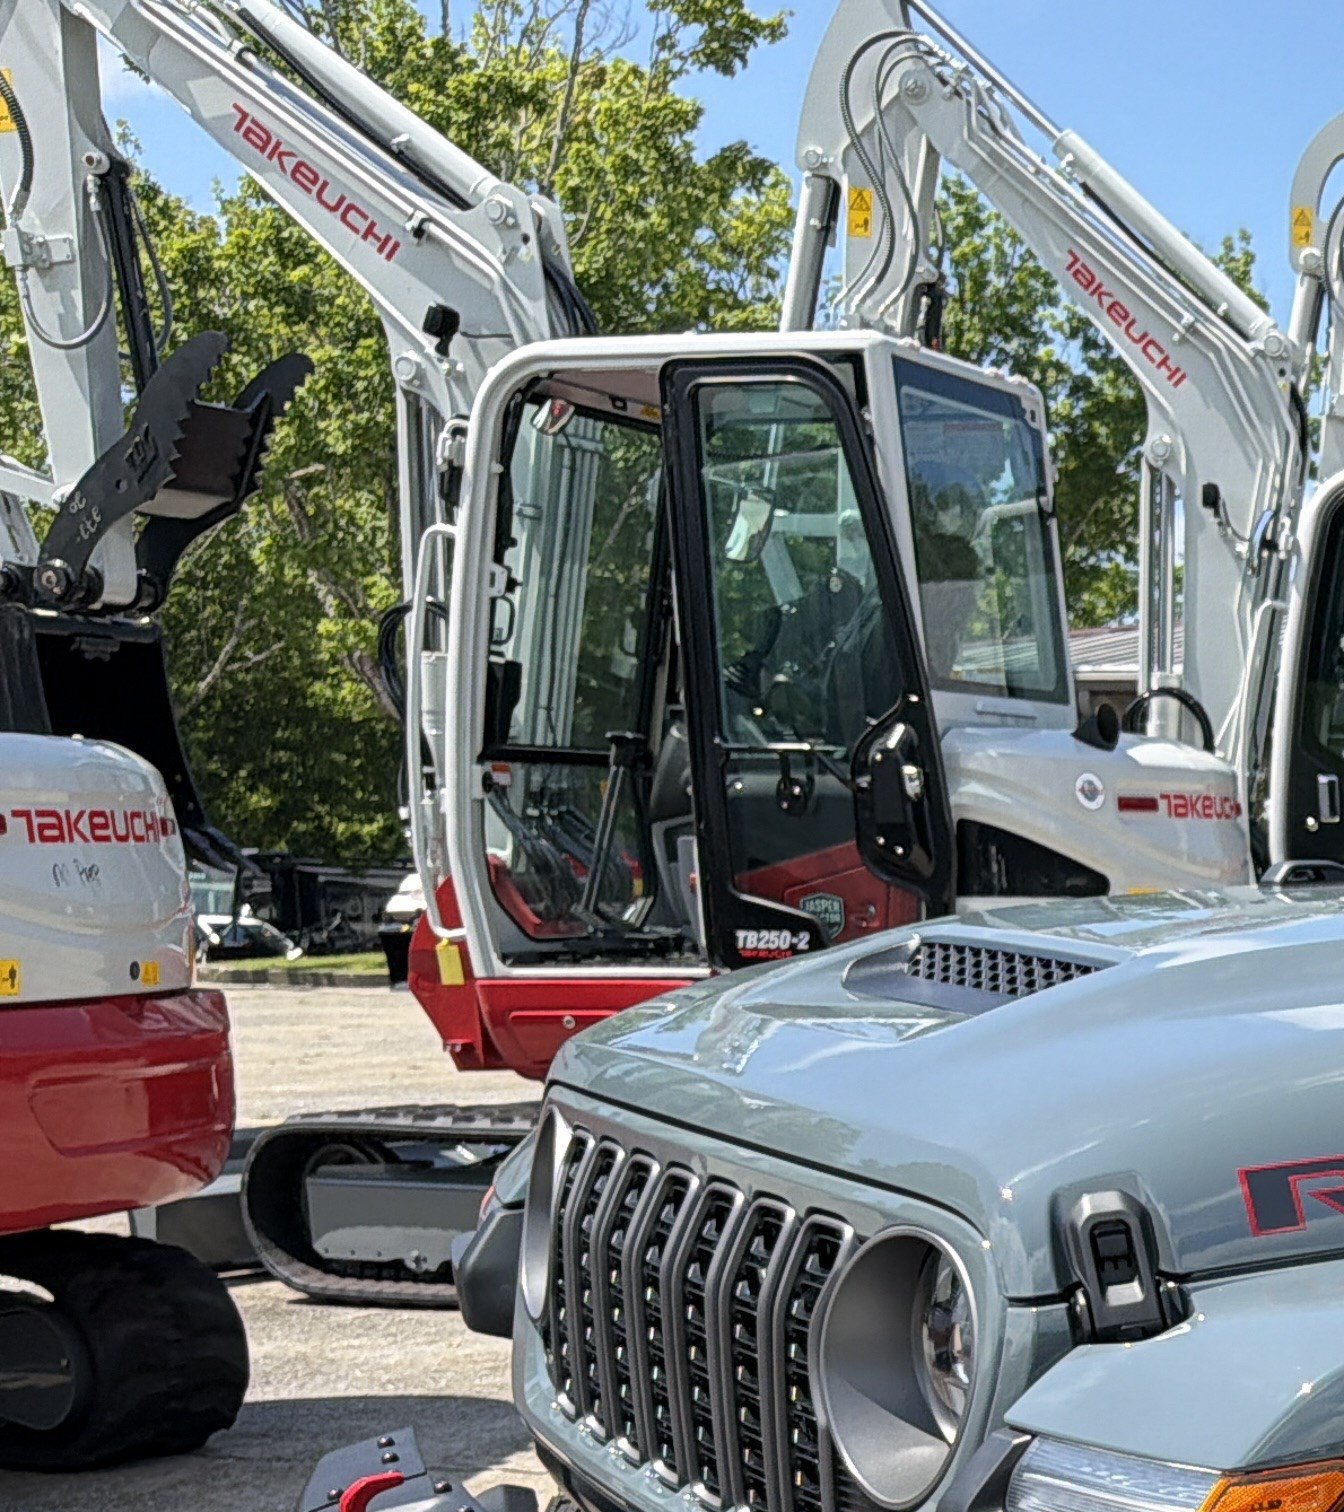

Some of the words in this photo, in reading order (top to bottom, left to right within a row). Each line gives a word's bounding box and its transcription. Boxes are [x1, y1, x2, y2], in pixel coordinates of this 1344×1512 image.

[232, 102, 401, 262] TAKEUCHI
[1065, 249, 1187, 388] TAKEUCHI
[735, 929, 811, 951] TB250-2
